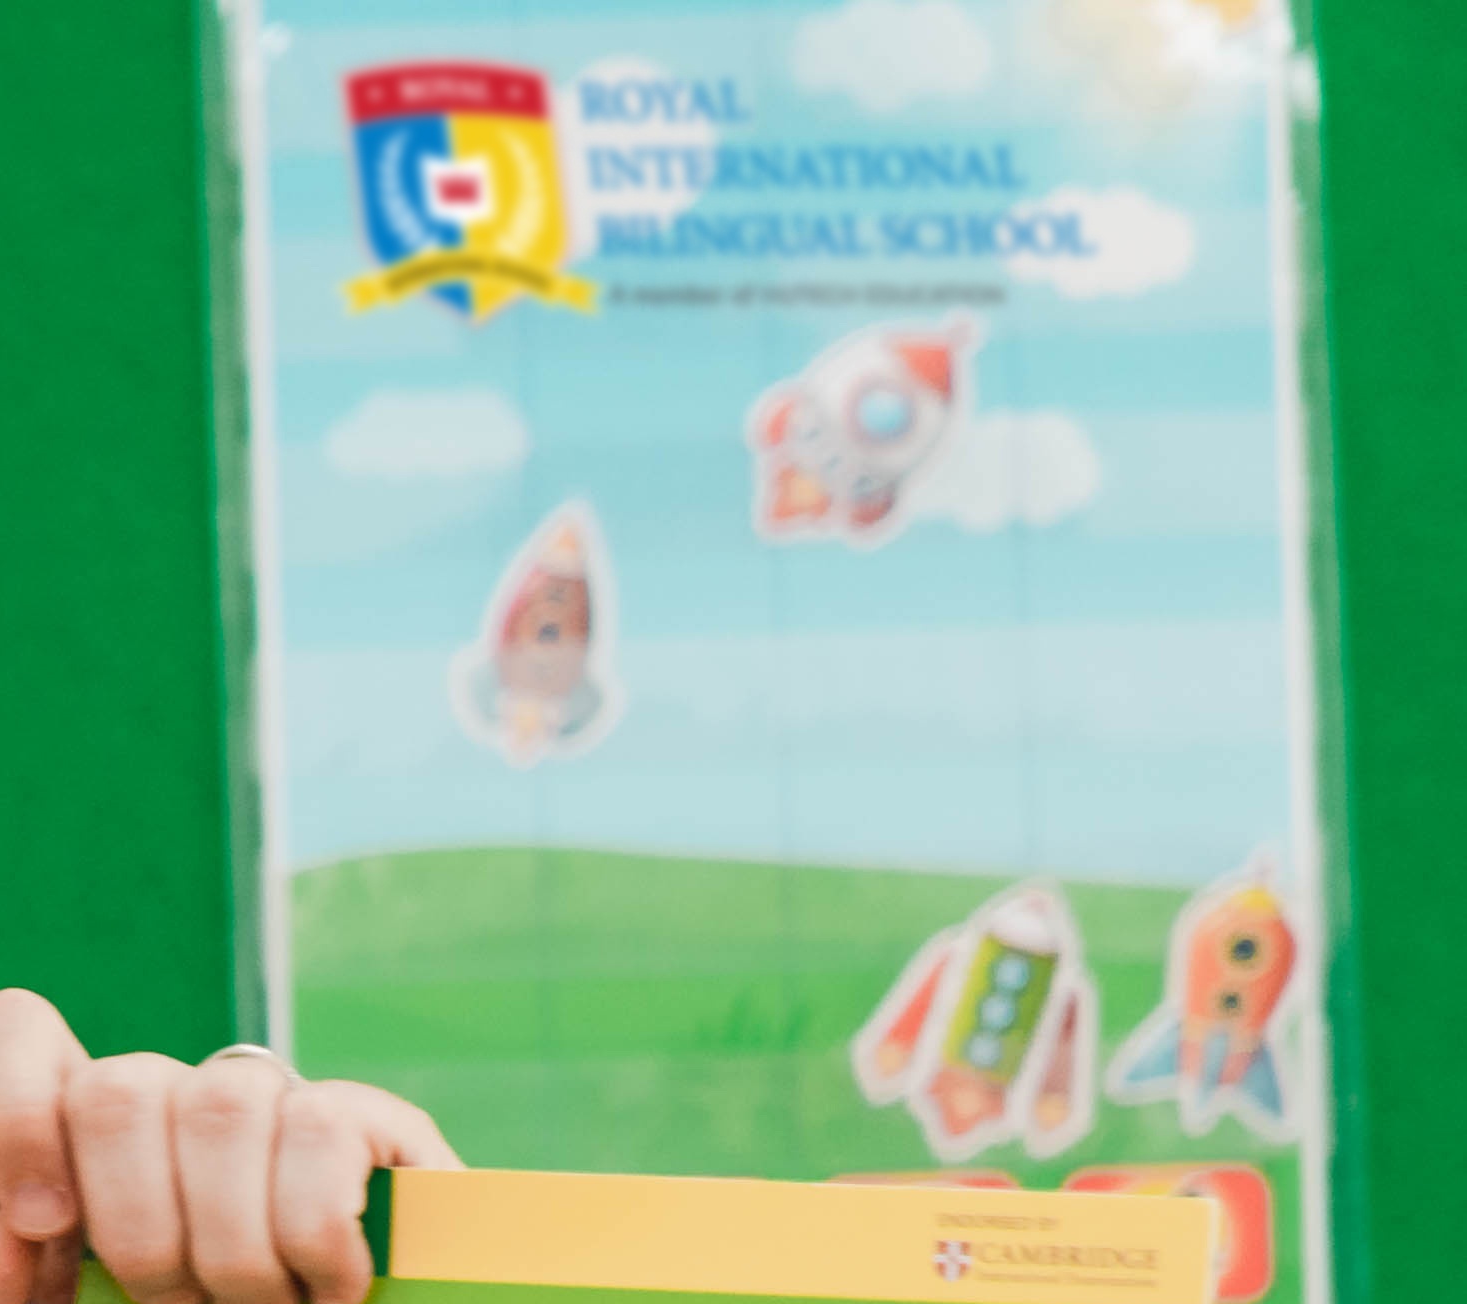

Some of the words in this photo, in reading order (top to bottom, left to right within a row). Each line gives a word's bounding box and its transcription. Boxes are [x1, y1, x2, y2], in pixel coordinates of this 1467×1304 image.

[579, 77, 752, 125] ROYAL
[586, 142, 1030, 192] INTERNATIONAL
[596, 208, 871, 259] BILINGUAL
[878, 210, 1100, 259] SCHOOL
[977, 1245, 1159, 1271] CAMBRIDGE
